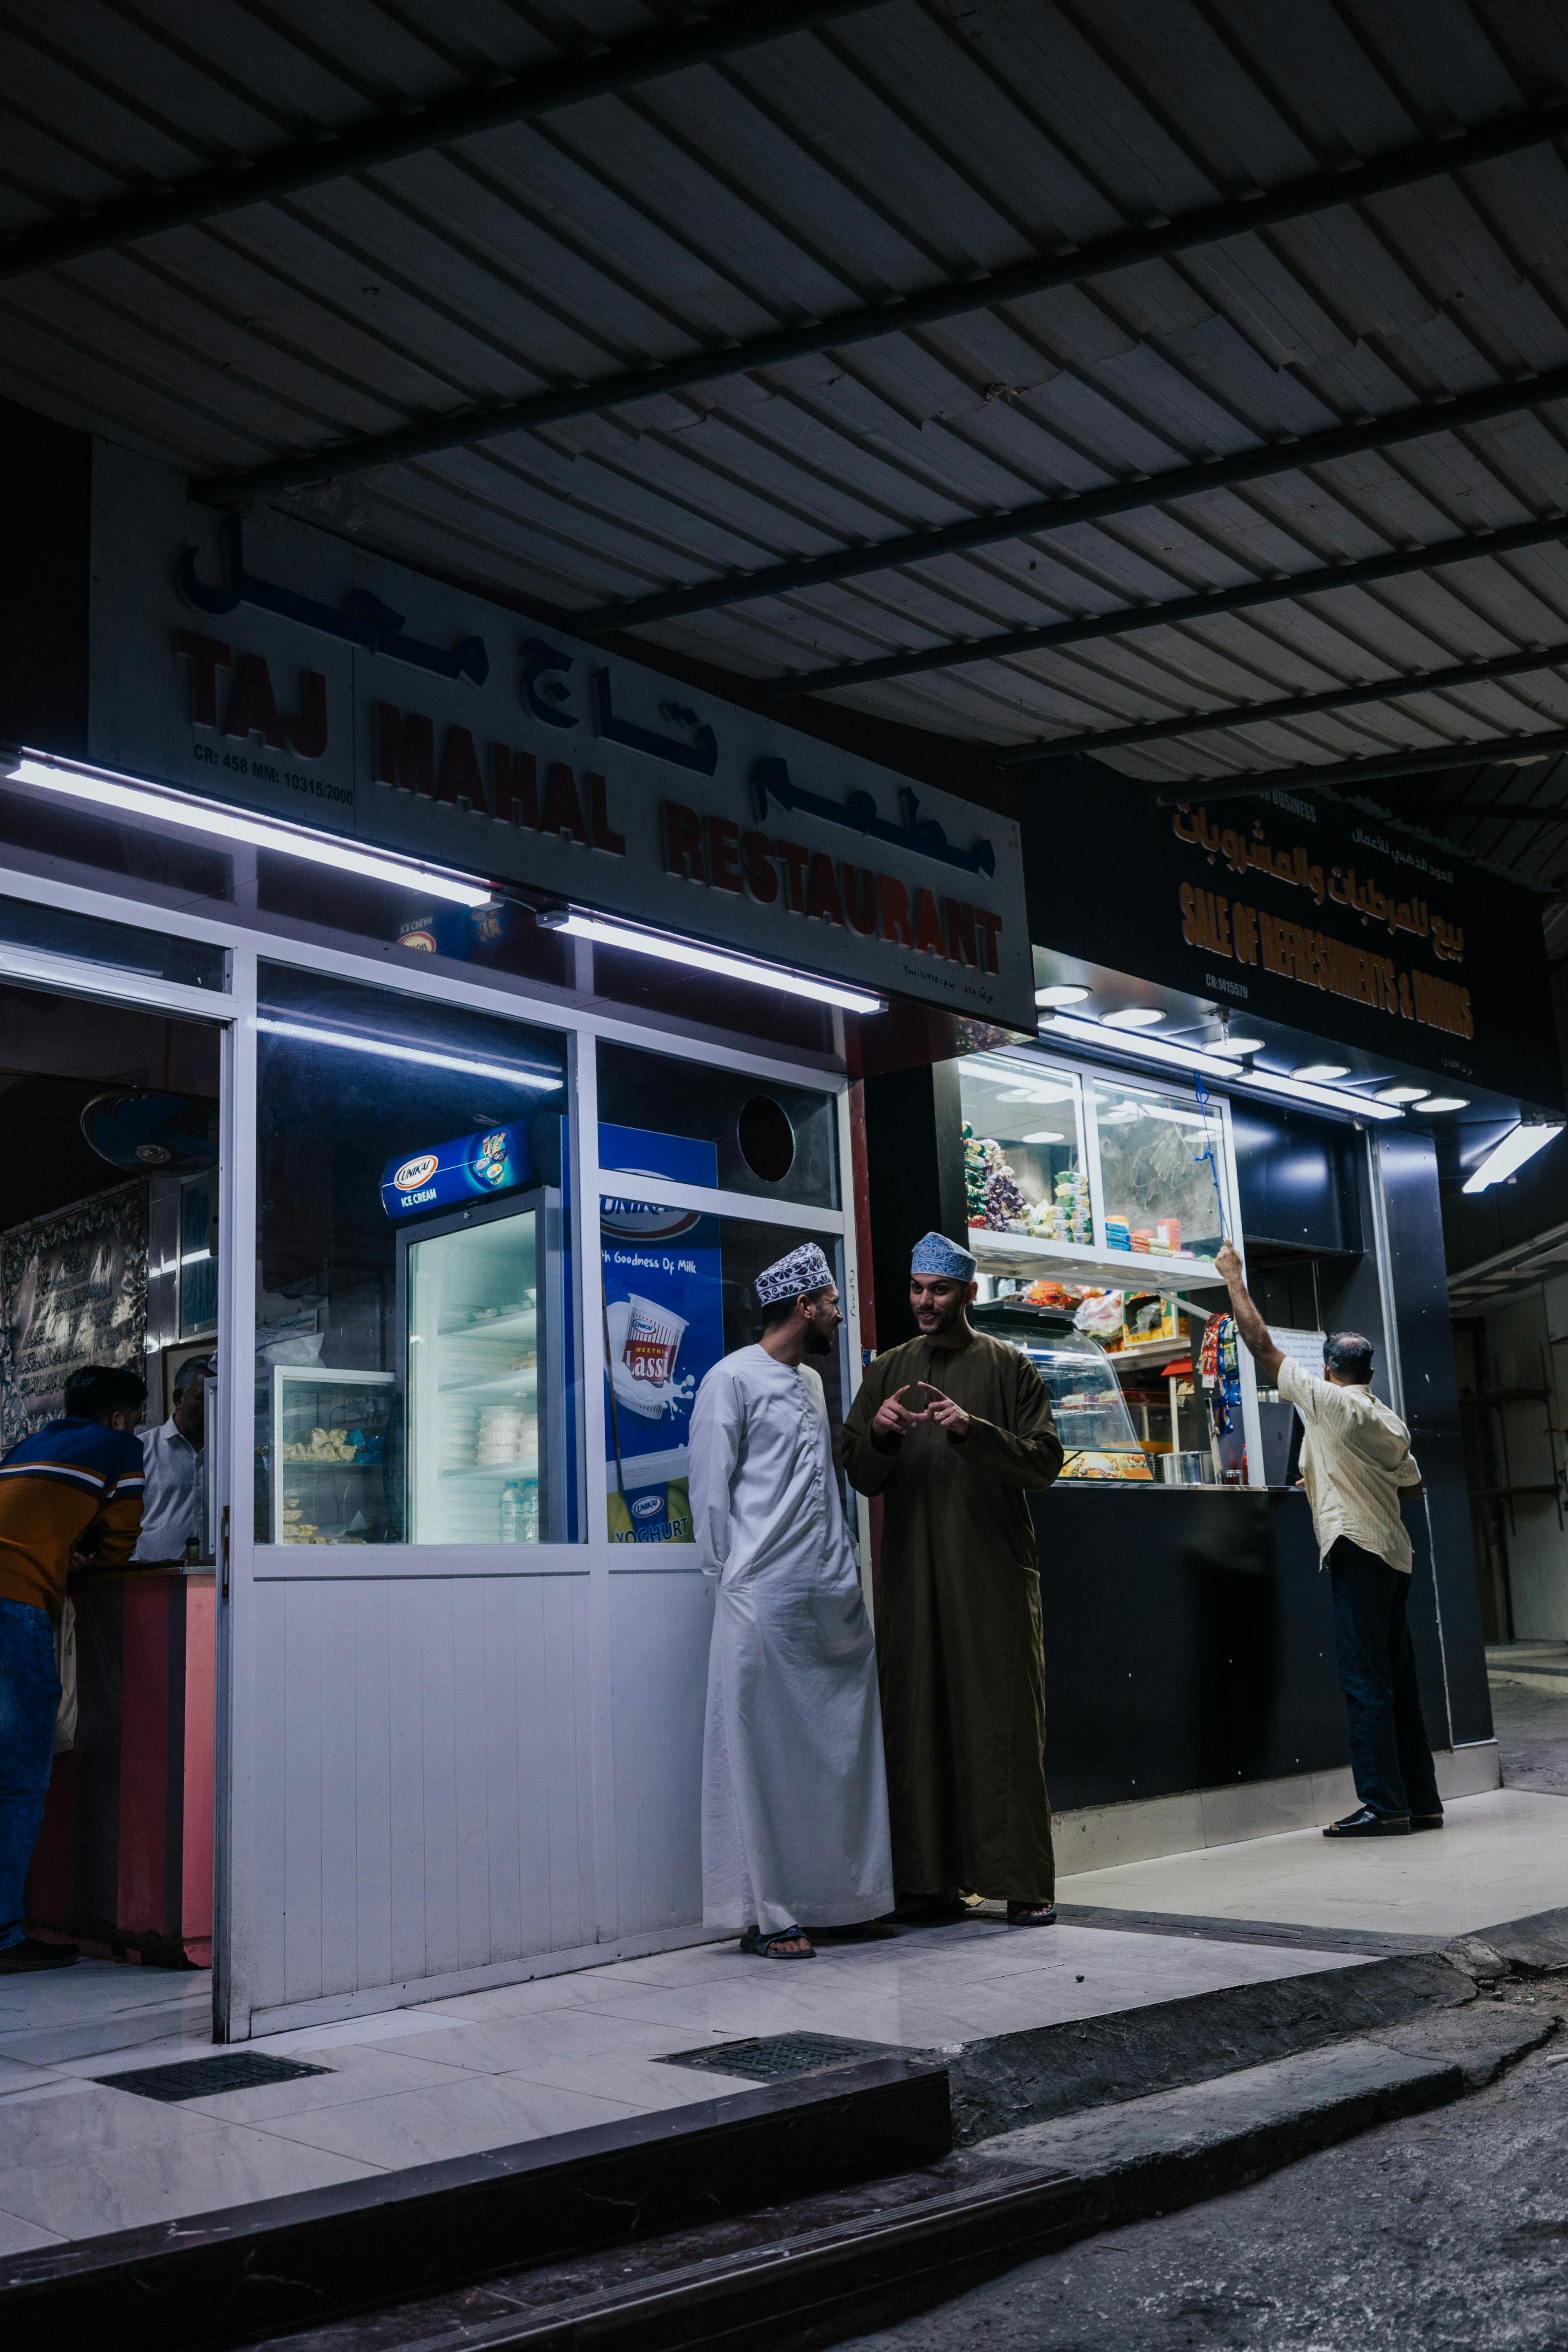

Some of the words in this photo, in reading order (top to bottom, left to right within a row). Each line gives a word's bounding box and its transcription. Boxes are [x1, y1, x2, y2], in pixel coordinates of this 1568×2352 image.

[176, 513, 489, 688] محل
[522, 638, 718, 777] تاج
[194, 744, 218, 765] CR:
[222, 753, 248, 774] 458
[252, 761, 279, 784] MM:
[284, 772, 353, 806] 10315/2000
[175, 628, 328, 760] TAJ
[373, 701, 626, 858] MAHAL
[665, 801, 1003, 976] RESTAURANT
[753, 757, 996, 879] مطعم
[1272, 790, 1317, 823] BUSINESS
[1171, 799, 1326, 906] والمشروبات
[1326, 865, 1430, 937] للمرطبات
[1430, 914, 1465, 963] بيع
[1178, 881, 1233, 958] SALE
[1231, 901, 1258, 966] OF
[1258, 911, 1399, 1015] REFRESHMENTS
[1398, 971, 1415, 1020] &
[1410, 968, 1475, 1040] DRINKS
[1205, 973, 1248, 999] CR:1415579
[401, 1160, 431, 1181] UNIKAI
[401, 1195, 412, 1207] ICE
[412, 1188, 437, 1204] CREAM
[614, 1251, 660, 1268] Goodness
[662, 1257, 675, 1275] Of
[677, 1259, 697, 1274] Milk
[634, 1321, 653, 1331] UNIKAI
[625, 1350, 669, 1378] Lassi
[636, 1347, 664, 1355] MEETHI
[637, 1498, 658, 1513] UNIKAI
[615, 1517, 688, 1543] YOGHURT
